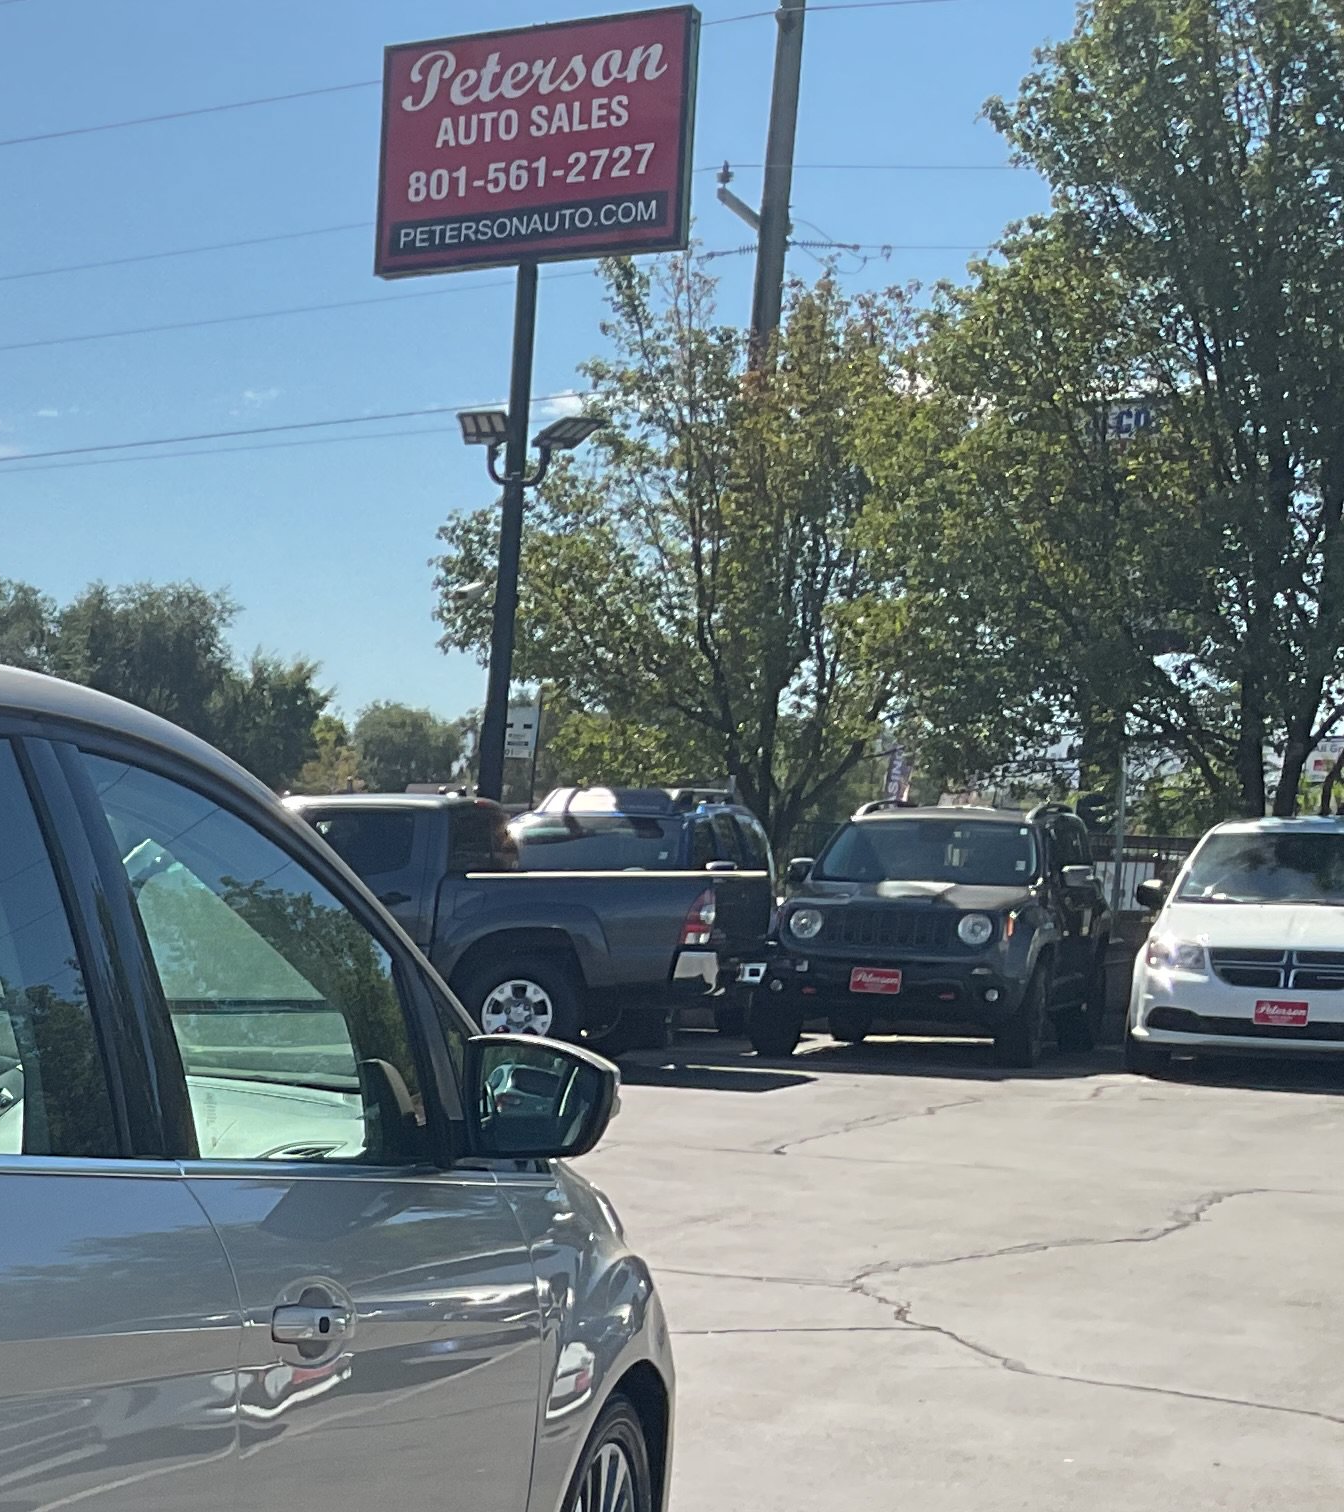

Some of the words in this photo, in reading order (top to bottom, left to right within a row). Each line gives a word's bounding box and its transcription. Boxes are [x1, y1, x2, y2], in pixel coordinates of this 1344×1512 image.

[401, 42, 668, 112] Peterson
[435, 109, 519, 148] AUTO
[529, 95, 629, 138] SALES
[407, 142, 655, 202] 801-561-2727
[399, 200, 657, 249] PETERSONAUTO.COM
